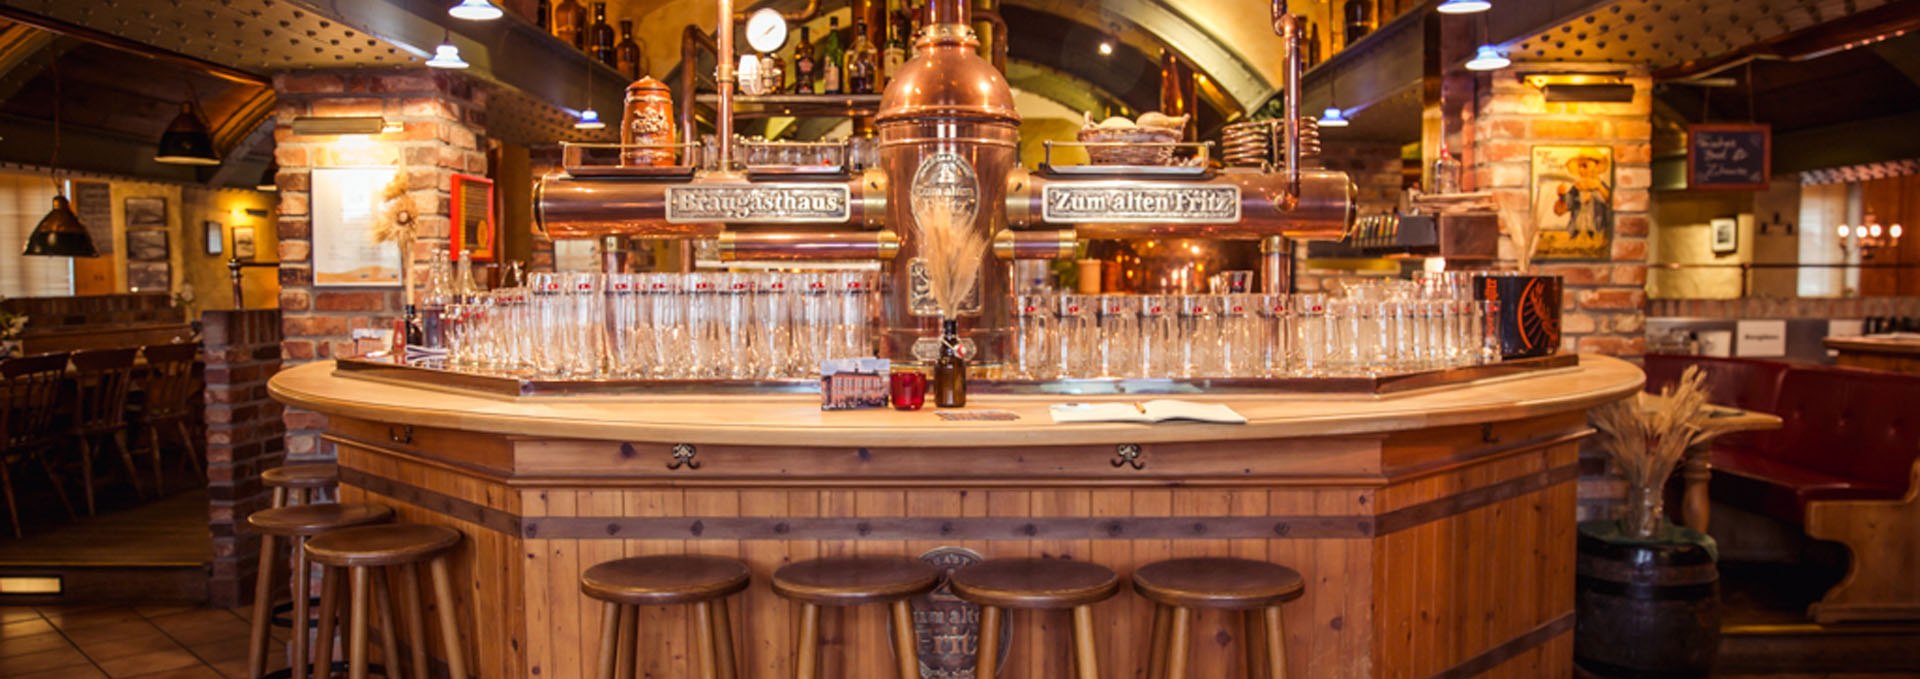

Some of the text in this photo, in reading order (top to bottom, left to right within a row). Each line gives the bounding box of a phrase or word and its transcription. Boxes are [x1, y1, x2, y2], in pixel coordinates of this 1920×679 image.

[679, 189, 838, 218] Braugasthaus
[1055, 190, 1234, 212] Zum alten Fritz
[913, 605, 979, 624] um alt
